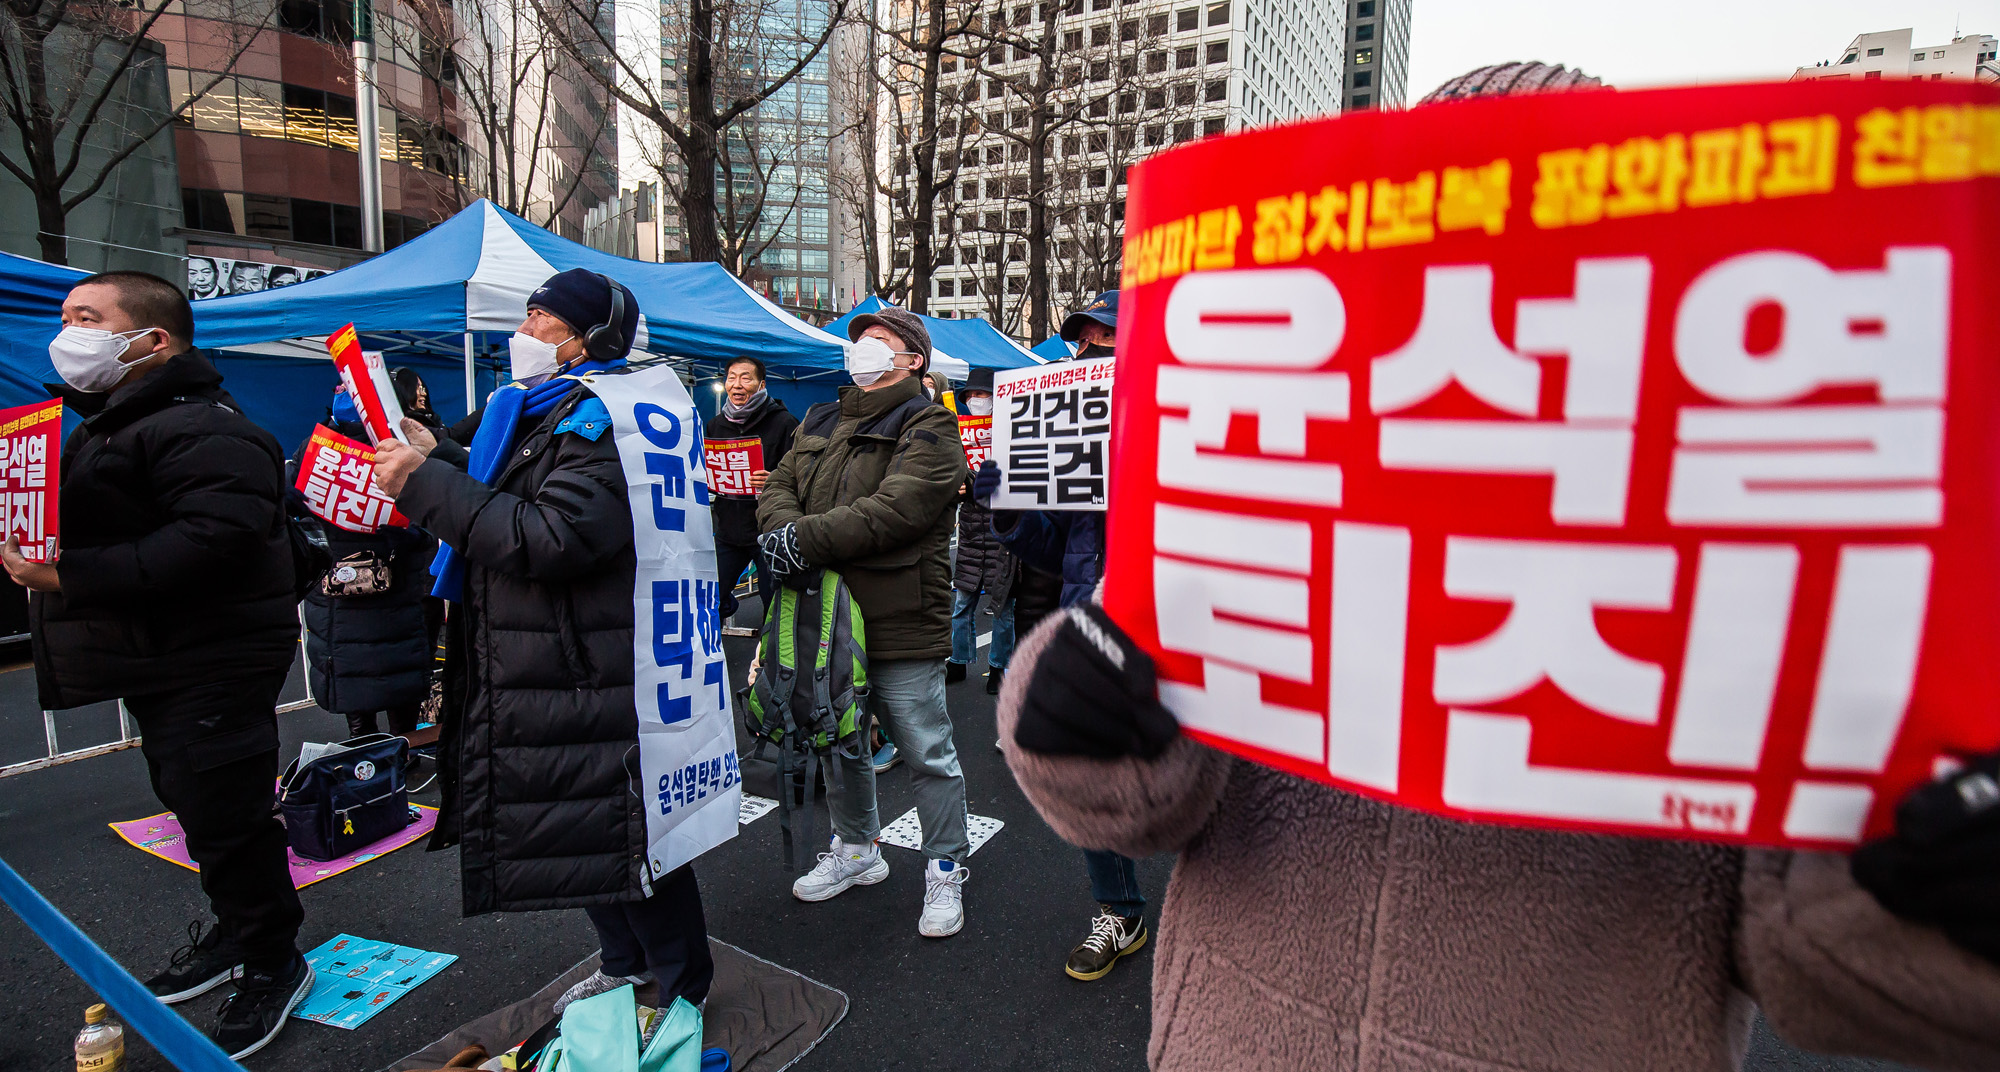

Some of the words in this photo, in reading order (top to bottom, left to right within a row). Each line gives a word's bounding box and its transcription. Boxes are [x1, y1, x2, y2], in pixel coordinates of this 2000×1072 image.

[1122, 204, 1243, 291] 민생파탄
[1252, 157, 1512, 266] 정치보복
[1530, 113, 1842, 230] 평화파괴
[996, 377, 1037, 399] 주가조작
[1040, 366, 1087, 390] 허위경력
[1155, 245, 1953, 528] 윤석열
[1007, 440, 1105, 506] 특검
[1152, 500, 1934, 845] 퇴진!
[658, 756, 721, 816] 윤석열탄핵
